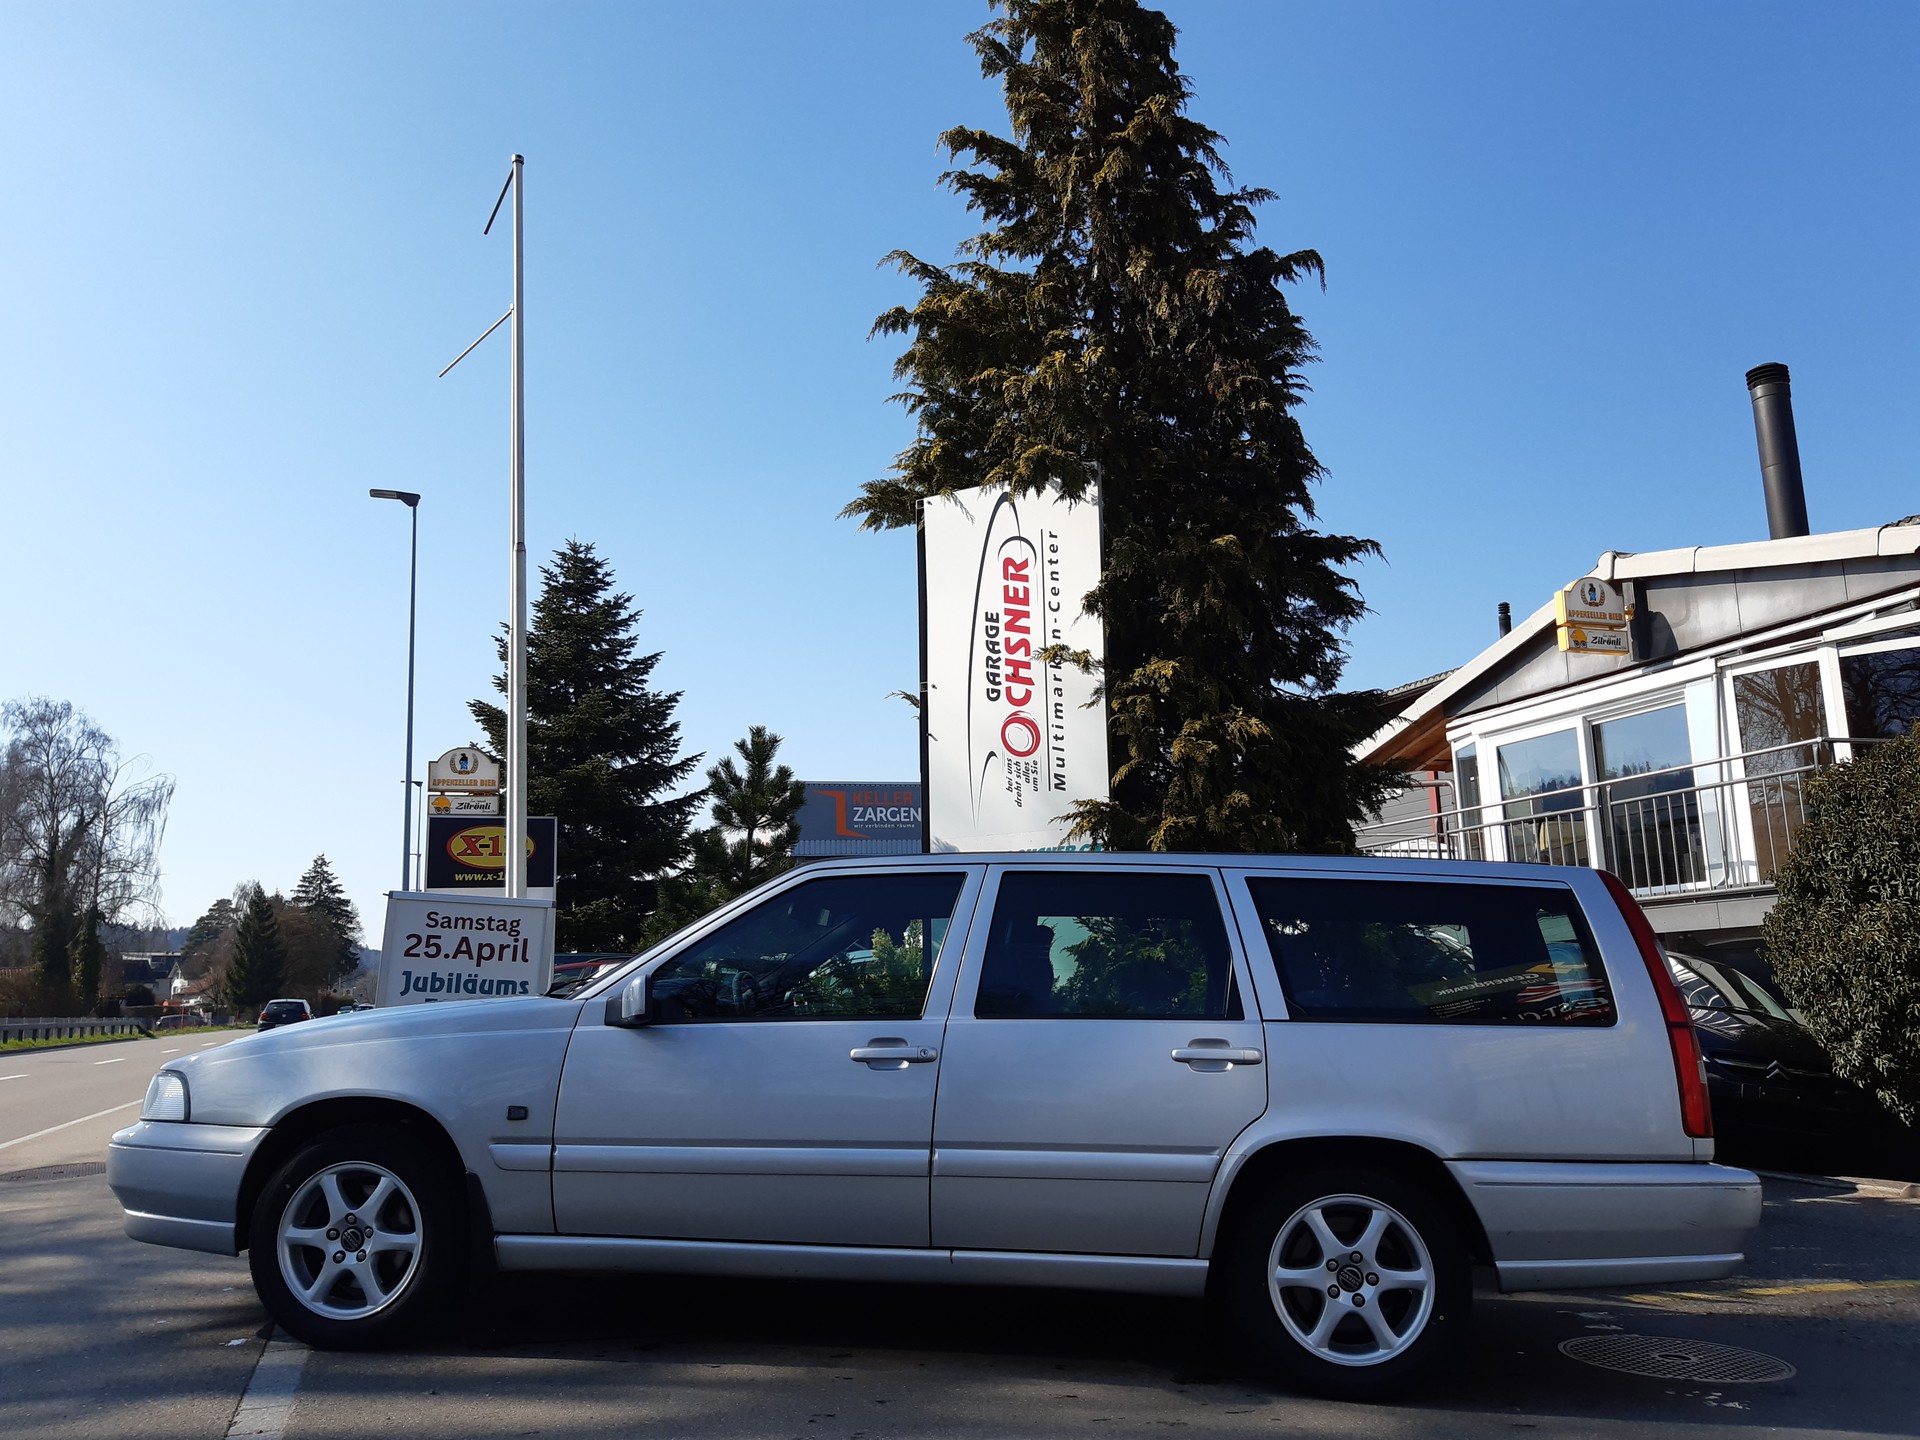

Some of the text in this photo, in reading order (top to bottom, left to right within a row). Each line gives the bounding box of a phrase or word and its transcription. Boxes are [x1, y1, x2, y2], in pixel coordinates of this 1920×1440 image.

[1568, 610, 1623, 621] APPENZELLER BIER
[1591, 636, 1621, 646] Zitrönli
[985, 611, 1001, 702] GARAGE
[1048, 530, 1067, 791] Multimarkn-Center
[1022, 761, 1030, 784] alles
[432, 779, 497, 787] APPENZELLER BIER
[1013, 761, 1022, 808] dreht sich
[1033, 777, 1039, 792] um
[455, 802, 491, 810] Zitrönli
[852, 791, 913, 806] KELLER
[853, 807, 922, 822] ZARGEN
[457, 835, 531, 857] X-1
[454, 871, 506, 881] www.x-1
[426, 911, 521, 938] Samstag
[400, 970, 529, 997] Jubiläums
[1340, 1271, 1360, 1287] VOLVO
